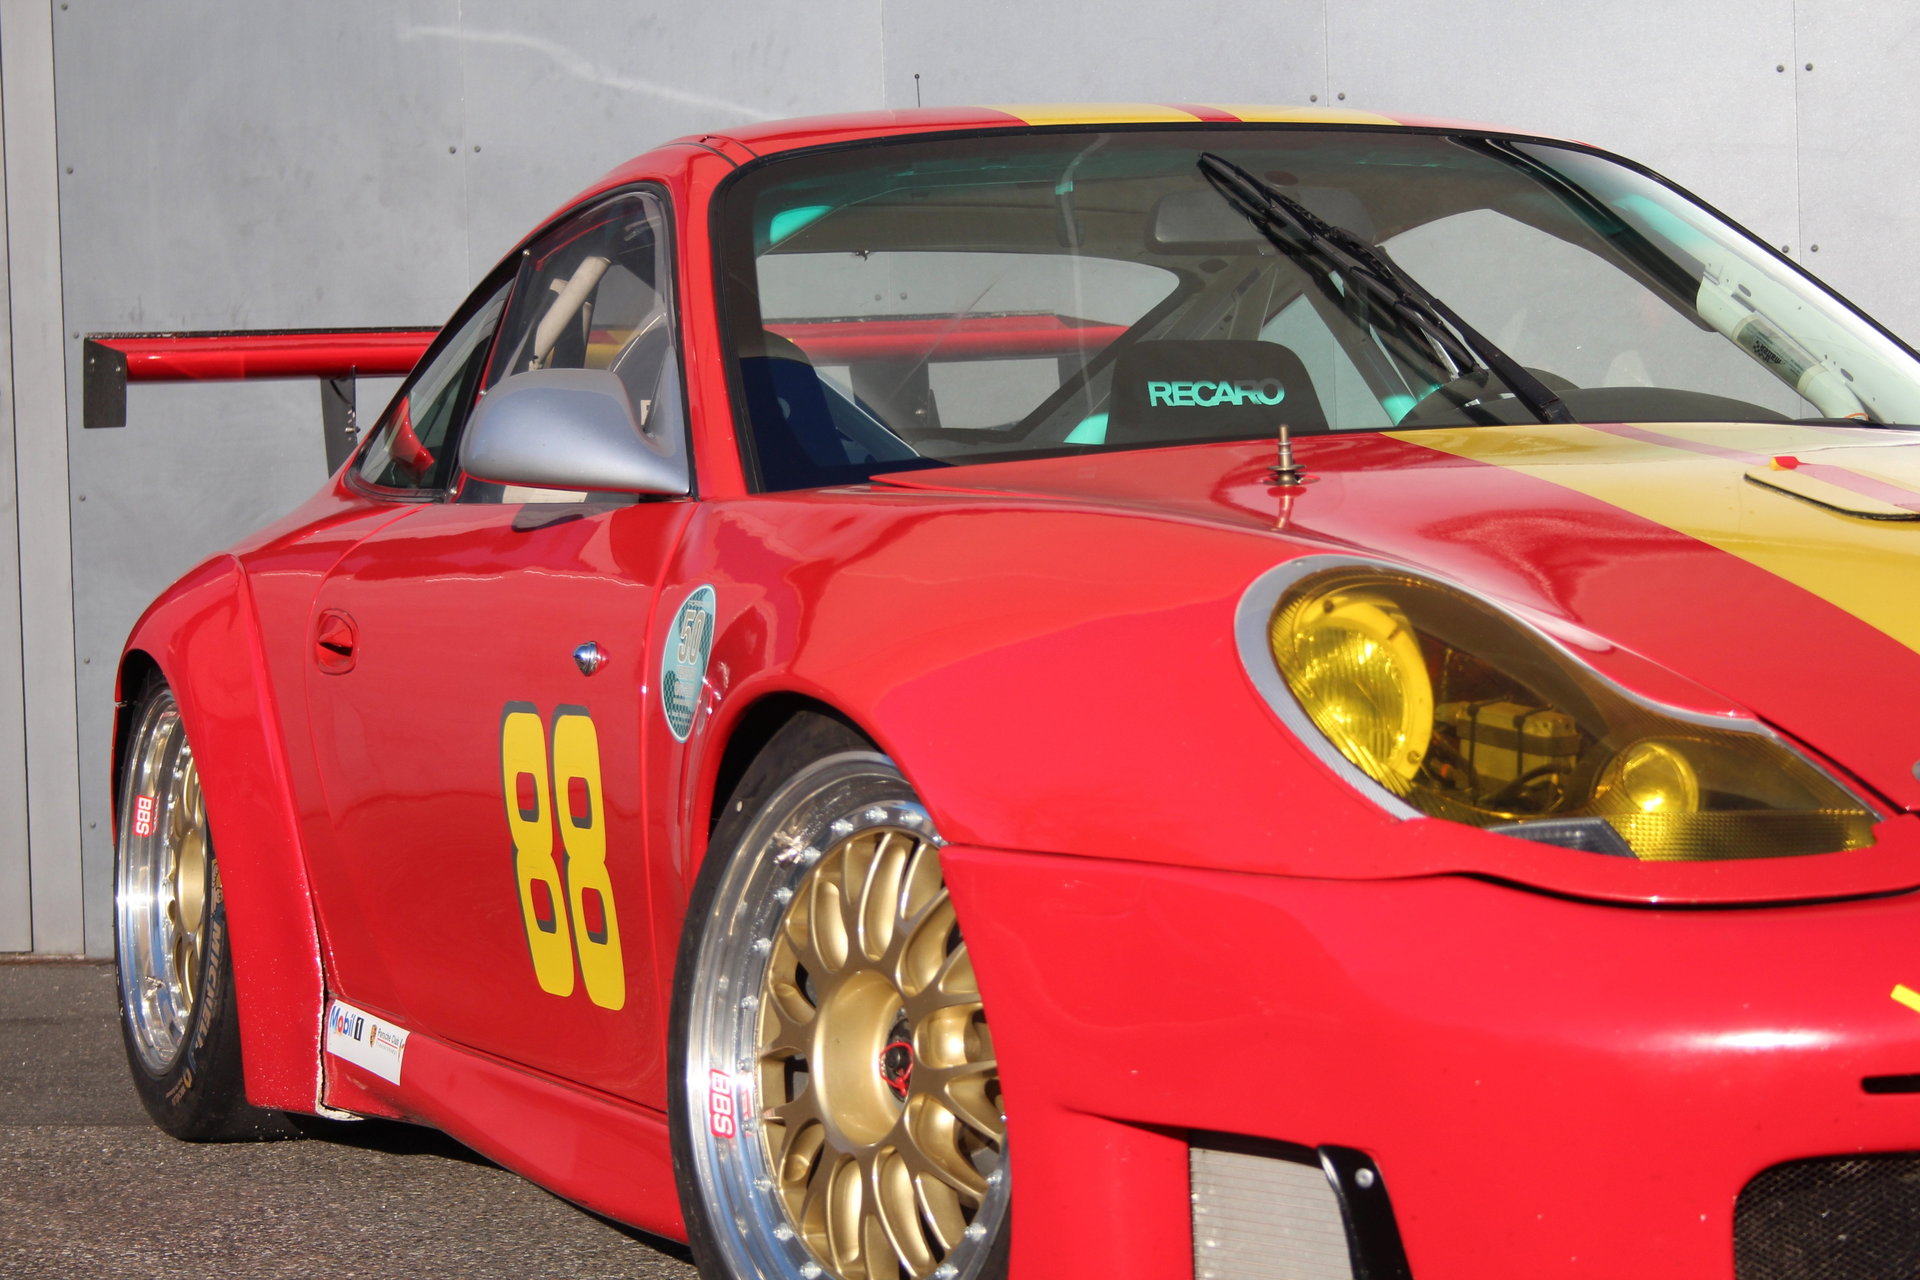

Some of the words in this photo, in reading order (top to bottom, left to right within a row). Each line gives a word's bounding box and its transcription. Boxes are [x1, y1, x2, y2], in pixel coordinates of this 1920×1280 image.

[1147, 378, 1285, 407] RECARO
[677, 609, 706, 665] 50
[135, 796, 152, 835] BBS
[500, 700, 626, 1011] 88
[330, 1005, 356, 1037] Mobil
[354, 1017, 364, 1041] 1
[711, 1071, 733, 1136] BBS
